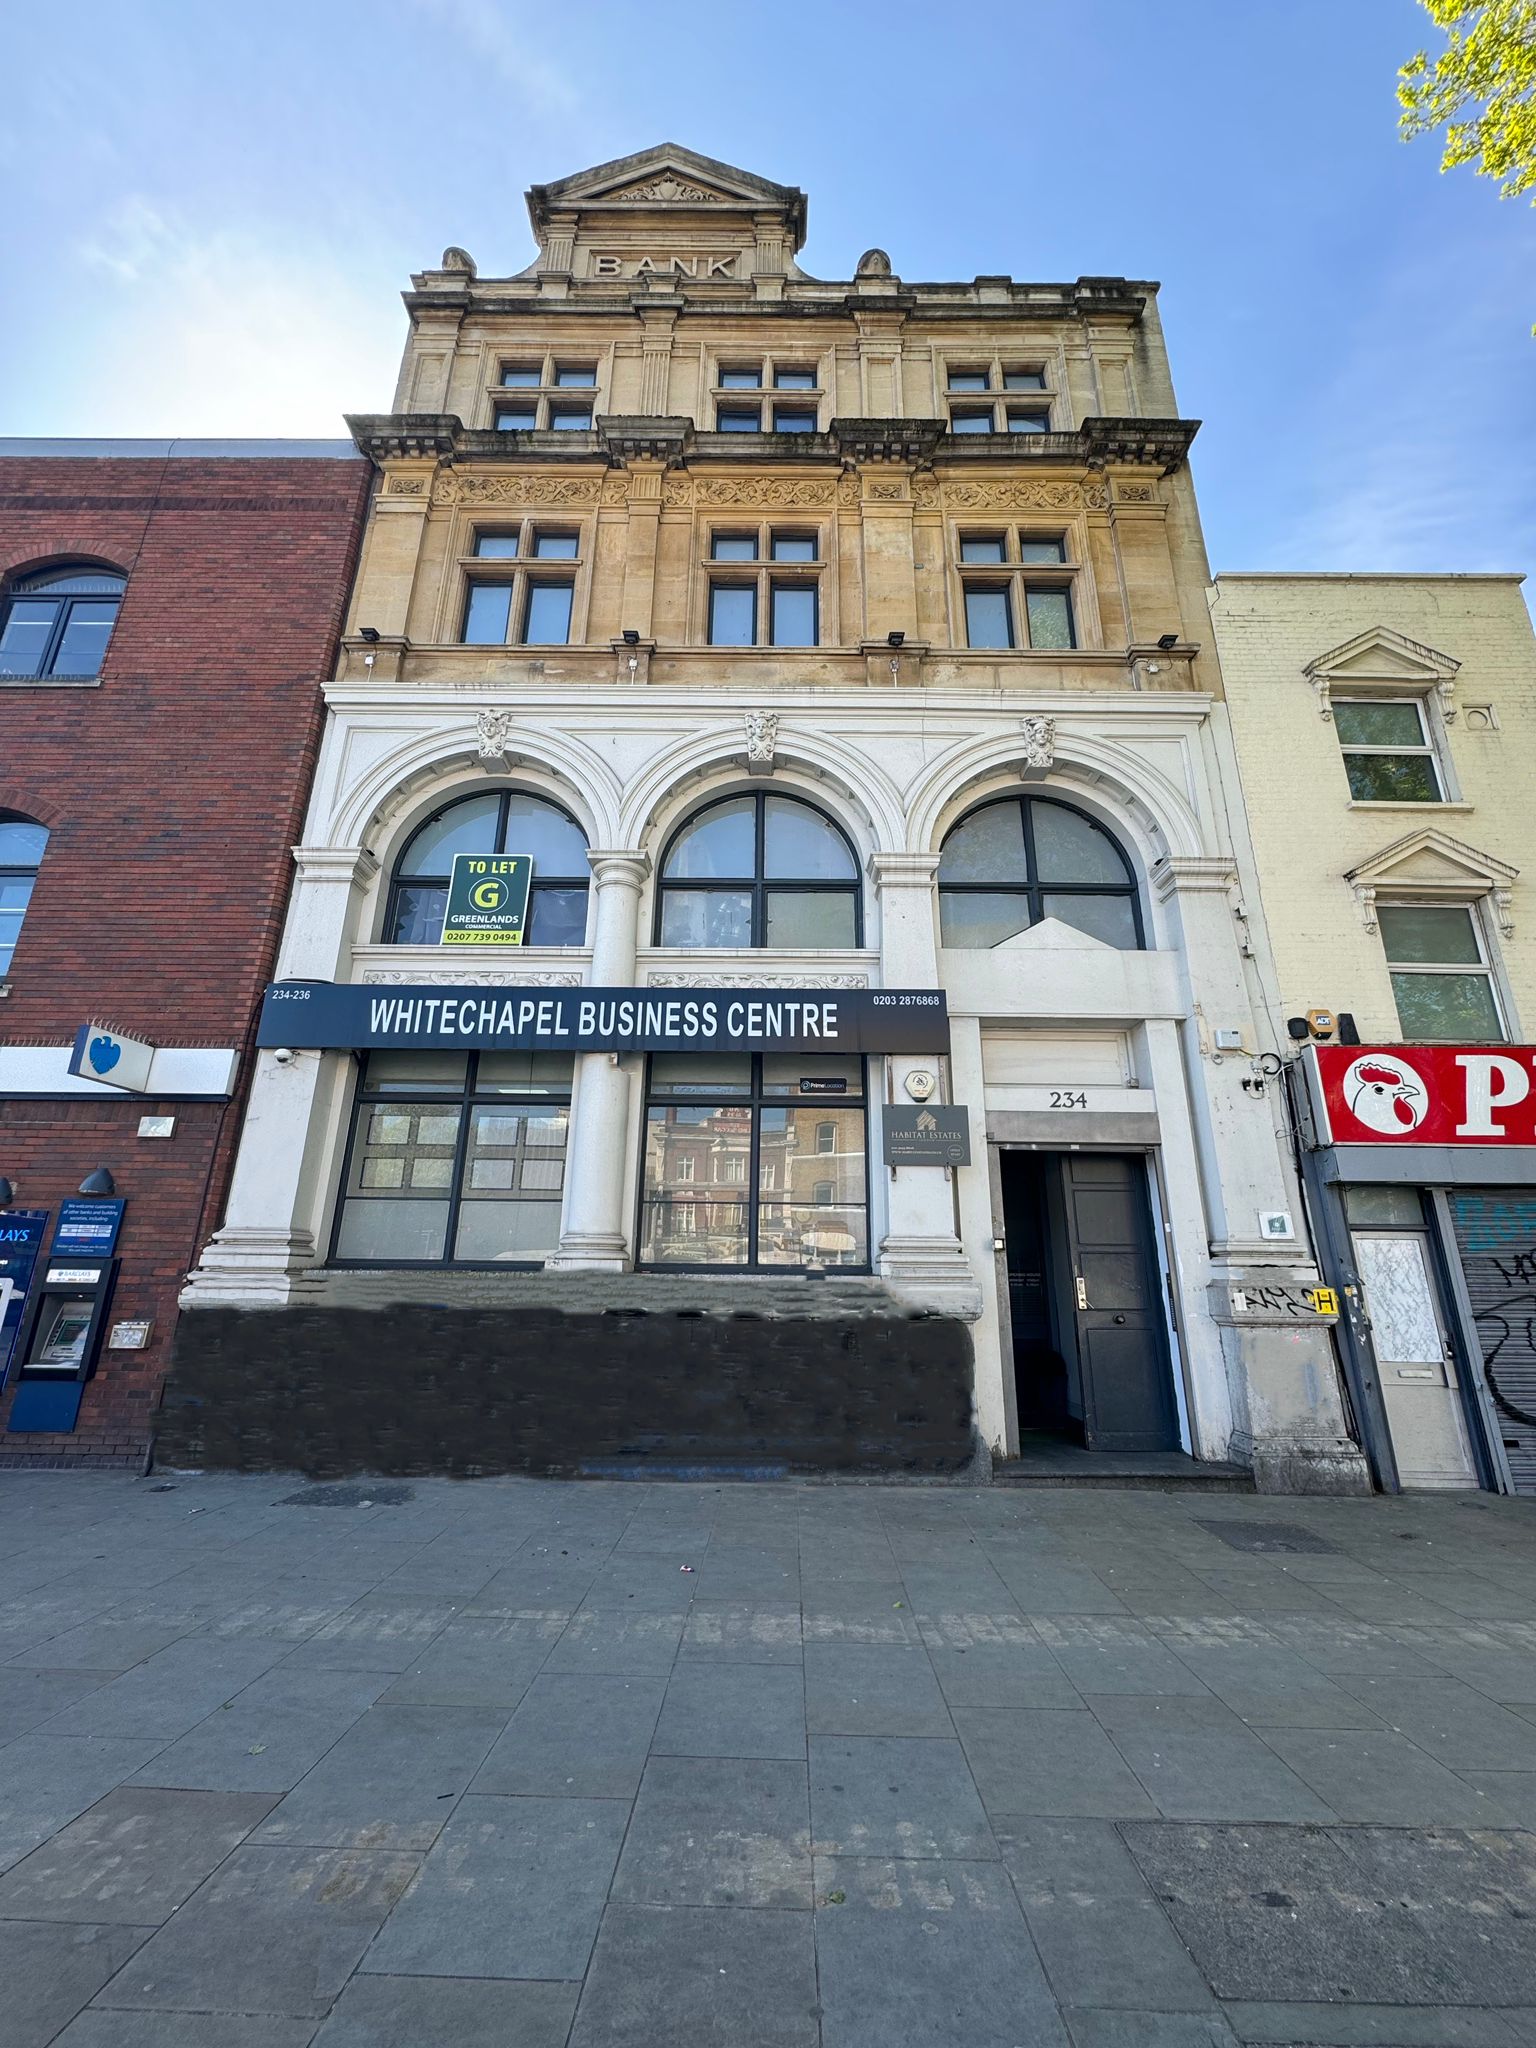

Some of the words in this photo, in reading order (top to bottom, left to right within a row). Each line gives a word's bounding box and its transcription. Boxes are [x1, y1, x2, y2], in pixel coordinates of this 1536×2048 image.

[594, 256, 734, 278] BANK
[468, 861, 487, 874] TO
[491, 861, 518, 874] LET
[474, 882, 499, 908] G
[450, 914, 519, 924] GREENLANDS
[447, 933, 471, 941] 0207
[473, 933, 491, 941] 739
[492, 933, 517, 941] 0494
[272, 990, 311, 1001] 234-236
[873, 995, 897, 1005] 0203
[899, 995, 940, 1006] 2876868
[370, 999, 570, 1036] WHITECHAPEL
[578, 1001, 718, 1037] BUSINESS
[727, 1002, 839, 1038] CENTRE
[1049, 1091, 1087, 1108] 234
[1455, 1054, 1536, 1137] P
[891, 1131, 926, 1139] HABITAT
[929, 1131, 962, 1140] ESTATES
[1317, 1291, 1334, 1311] H
